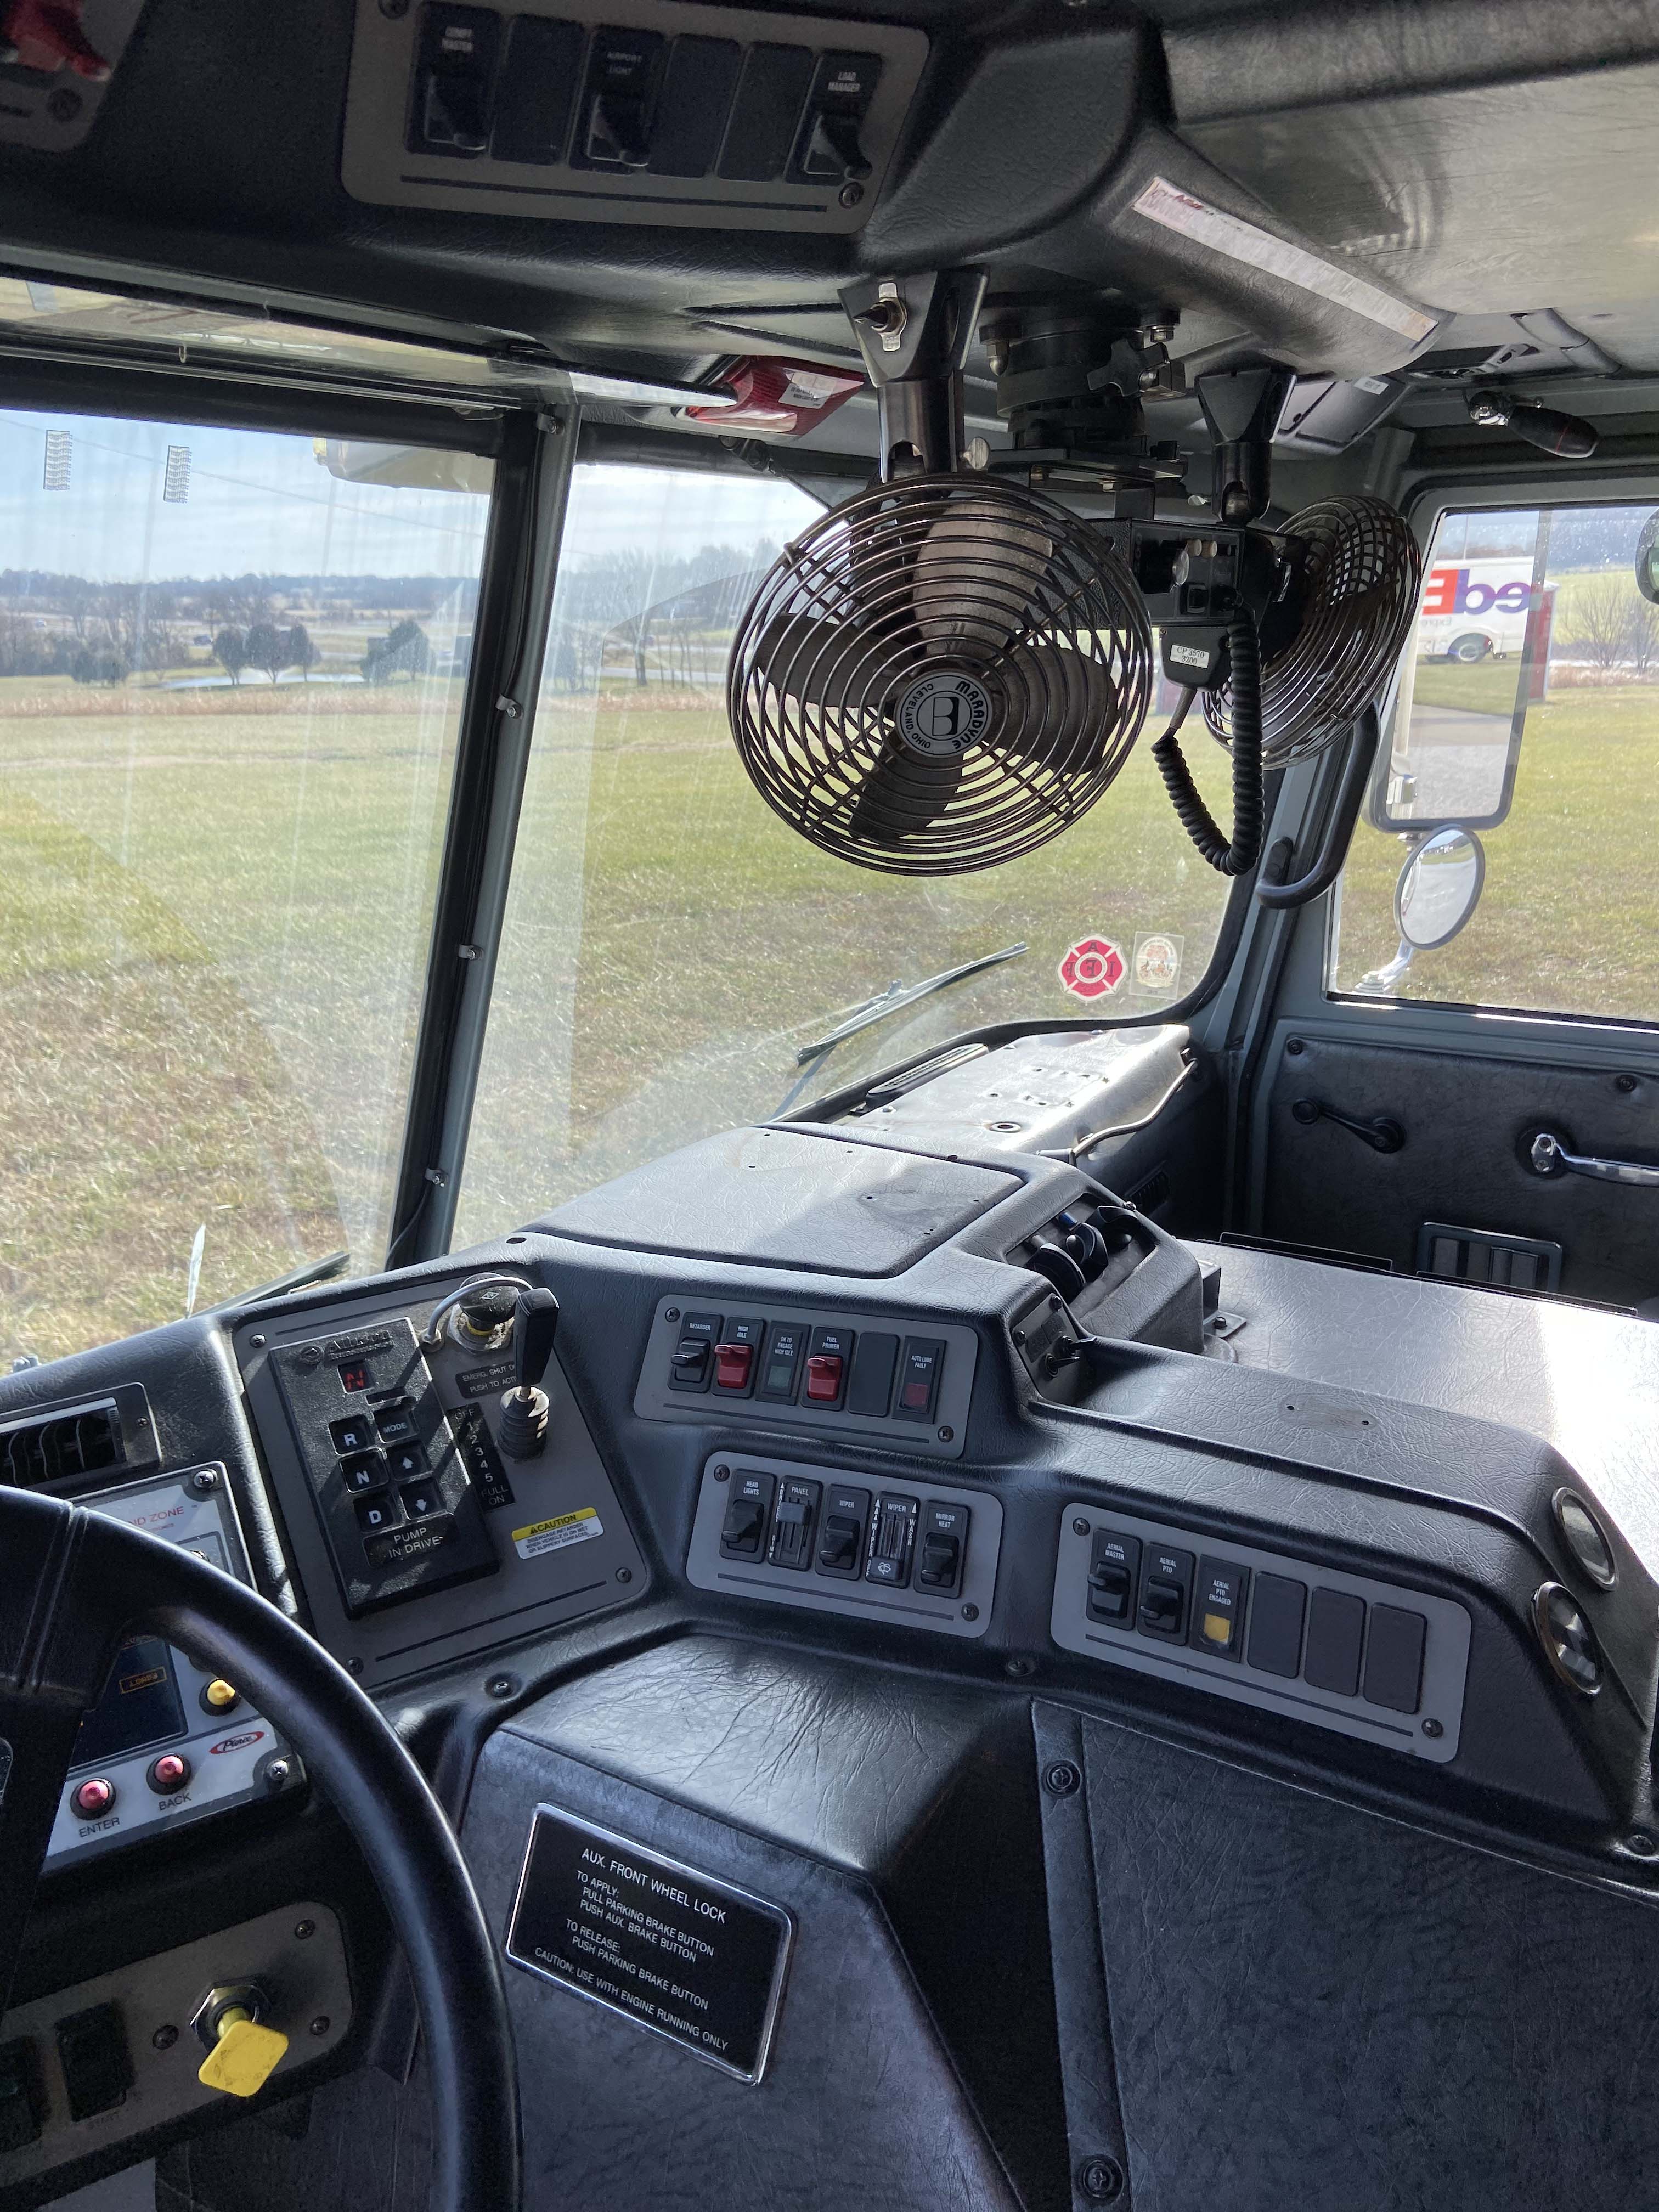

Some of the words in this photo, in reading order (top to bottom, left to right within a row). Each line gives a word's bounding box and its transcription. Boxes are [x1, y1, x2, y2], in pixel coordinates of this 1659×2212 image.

[1188, 648, 1205, 658] 3570
[1181, 655, 1197, 665] 3200
[952, 681, 985, 749] MARADYNE
[462, 1371, 488, 1382] EMERG.
[489, 1365, 507, 1375] SHUT
[345, 1370, 365, 1390] N
[470, 1382, 488, 1393] PUSH
[455, 1409, 475, 1420] OFF
[383, 1421, 407, 1434] MODE
[343, 1433, 358, 1447] R
[470, 1435, 479, 1444] 2
[475, 1447, 484, 1456] 3
[481, 1460, 488, 1469] 4
[356, 1470, 370, 1485] N
[485, 1473, 493, 1482] 5
[481, 1485, 509, 1497] FULL
[743, 1487, 759, 1496] LIGHTS
[791, 1486, 809, 1496] PANEL
[489, 1494, 505, 1506] ON
[839, 1499, 855, 1508] WIPER
[149, 1506, 185, 1522] ZONE
[887, 1503, 906, 1513] WIPER
[368, 1510, 382, 1525] D
[536, 1514, 577, 1532] CAUTION
[935, 1513, 955, 1522] MIRROR
[938, 1520, 951, 1528] HEAT
[393, 1527, 427, 1545] PUMP
[527, 1531, 556, 1543] DISENGAGE
[557, 1522, 583, 1534] RETARDER
[907, 1519, 916, 1545] WASH
[537, 1539, 562, 1551] SLIPPERY
[542, 1534, 562, 1545] VEHICLE
[388, 1547, 402, 1559] IN
[406, 1536, 442, 1554] DRIVE
[1107, 1543, 1124, 1553] AERIAL
[1105, 1549, 1125, 1560] MASTER
[1159, 1556, 1177, 1567] AERIAL
[1163, 1565, 1172, 1573] PTO
[1212, 1579, 1230, 1590] AERIAL
[1216, 1588, 1226, 1596] PTO
[1209, 1593, 1231, 1605] ENGAGED
[159, 1792, 193, 1811] BACK
[78, 1816, 120, 1838] ENTER
[577, 1870, 589, 1882] TO
[590, 1877, 620, 1898] APPLY:
[582, 1848, 606, 1869] AUX.
[610, 1860, 648, 1886] FRONT
[651, 1878, 690, 1906] WHEEL
[694, 1899, 727, 1924] LOCK
[583, 1887, 604, 1904] PULL
[606, 1897, 644, 1922] PARKING
[645, 1916, 676, 1938] BRAKE
[678, 1932, 714, 1957] BUTTON
[566, 1918, 578, 1931] TO
[580, 1926, 621, 1953] RELEASE:
[580, 1899, 604, 1917] PUSH
[605, 1912, 625, 1928] AUX.
[628, 1922, 659, 1944] BRAKE
[660, 1937, 697, 1963] BUTTON
[572, 1936, 596, 1954] PUSH
[597, 1948, 637, 1974] PARKING
[638, 1968, 670, 1991] BRAKE
[671, 1984, 709, 2010] BUTTON
[535, 1947, 575, 1974] CAUTION:
[577, 1967, 595, 1983] USE
[596, 1977, 619, 1996] WITH
[621, 1990, 656, 2015] ENGINE
[657, 2008, 700, 2036] RUNNING
[702, 2031, 729, 2051] ONLY
